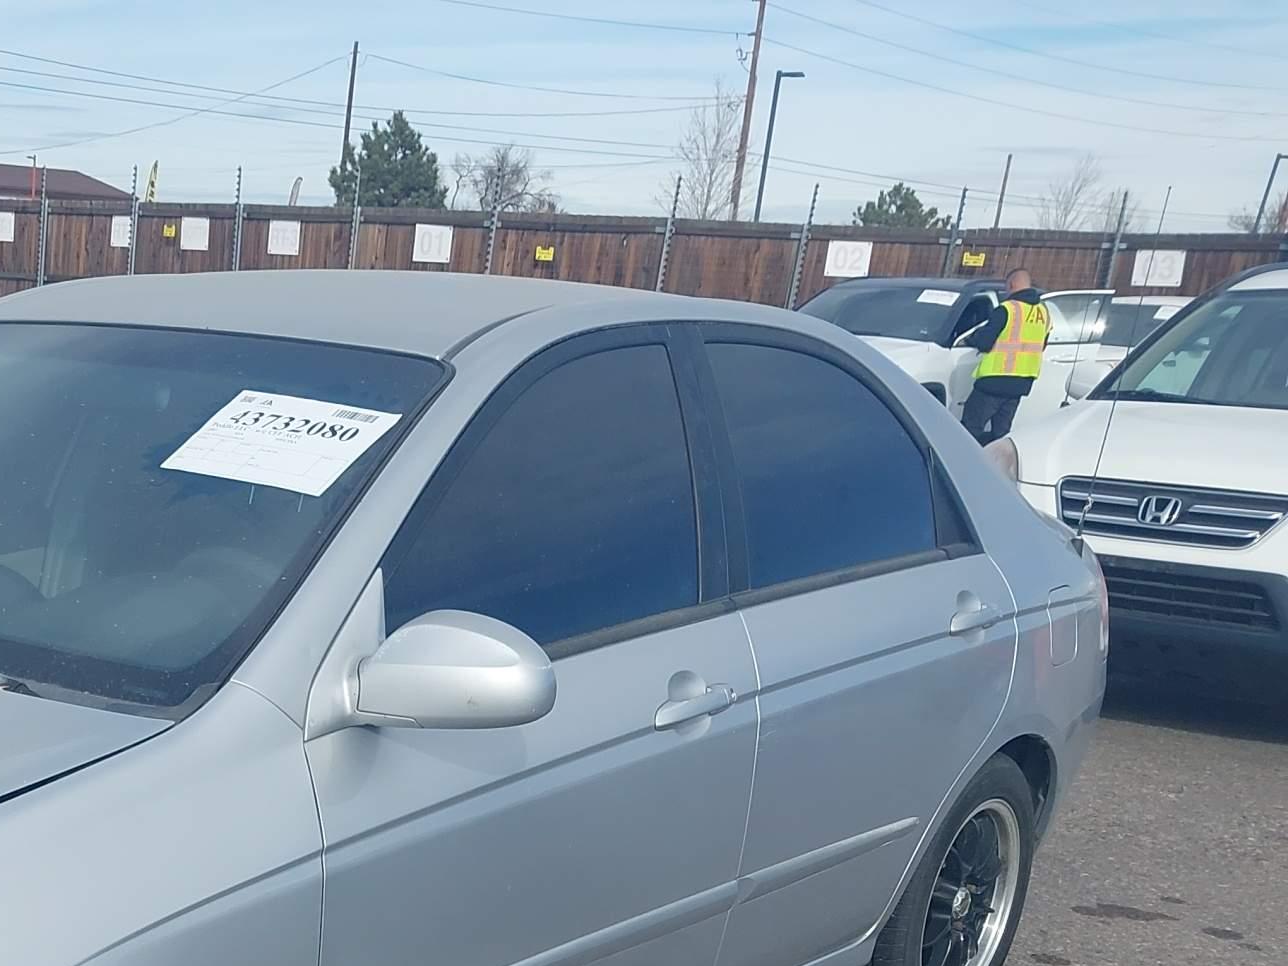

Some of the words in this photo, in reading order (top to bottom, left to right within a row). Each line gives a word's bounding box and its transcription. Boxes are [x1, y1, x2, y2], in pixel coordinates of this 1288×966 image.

[420, 230, 445, 256] 01
[833, 245, 865, 271] 02
[229, 410, 360, 442] 43732080
